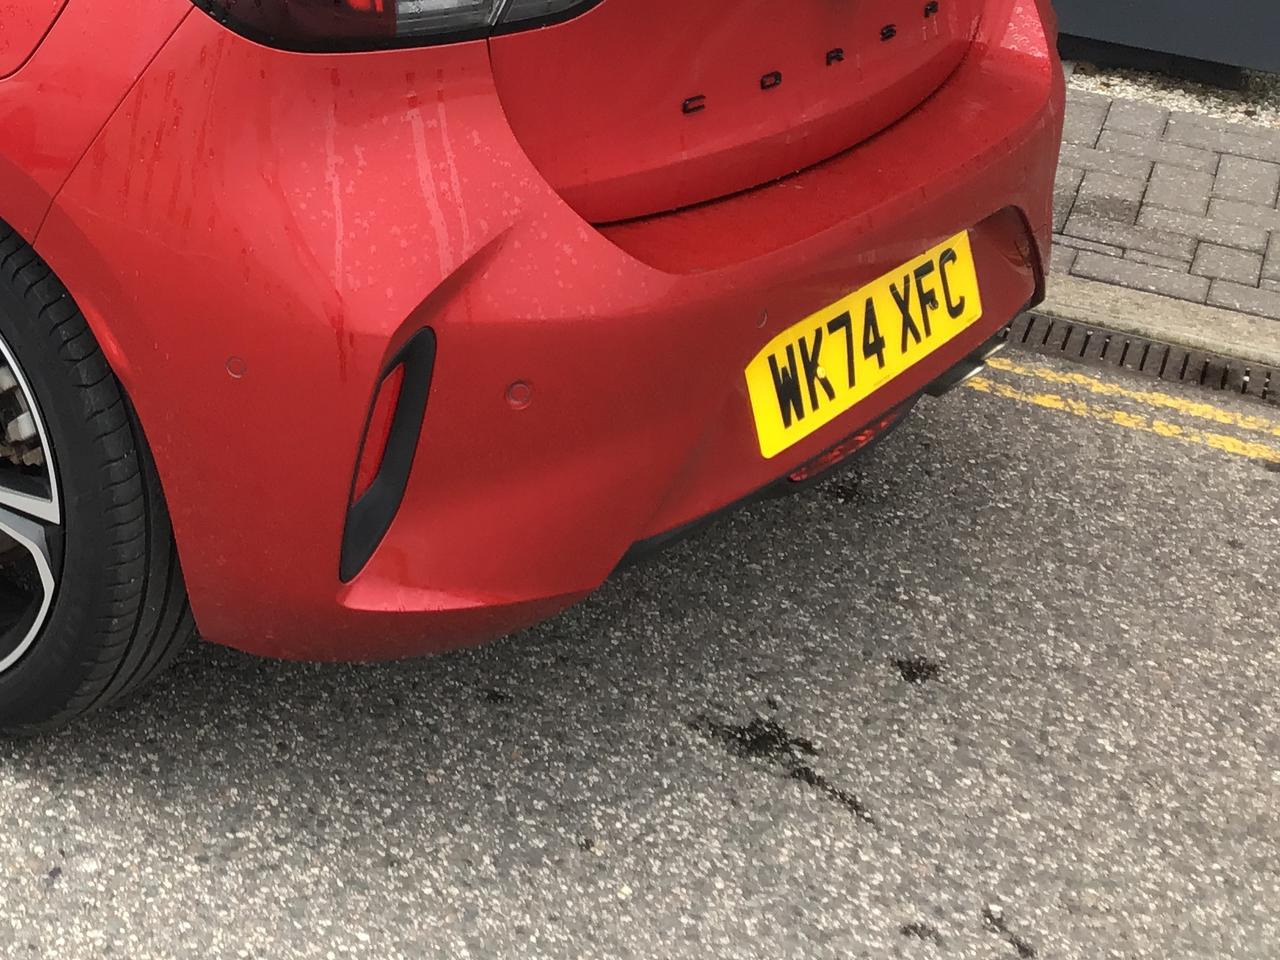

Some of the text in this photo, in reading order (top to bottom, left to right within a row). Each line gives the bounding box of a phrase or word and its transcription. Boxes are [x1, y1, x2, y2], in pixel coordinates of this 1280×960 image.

[682, 0, 939, 115] CORSA
[767, 248, 966, 430] WK74 XFC
